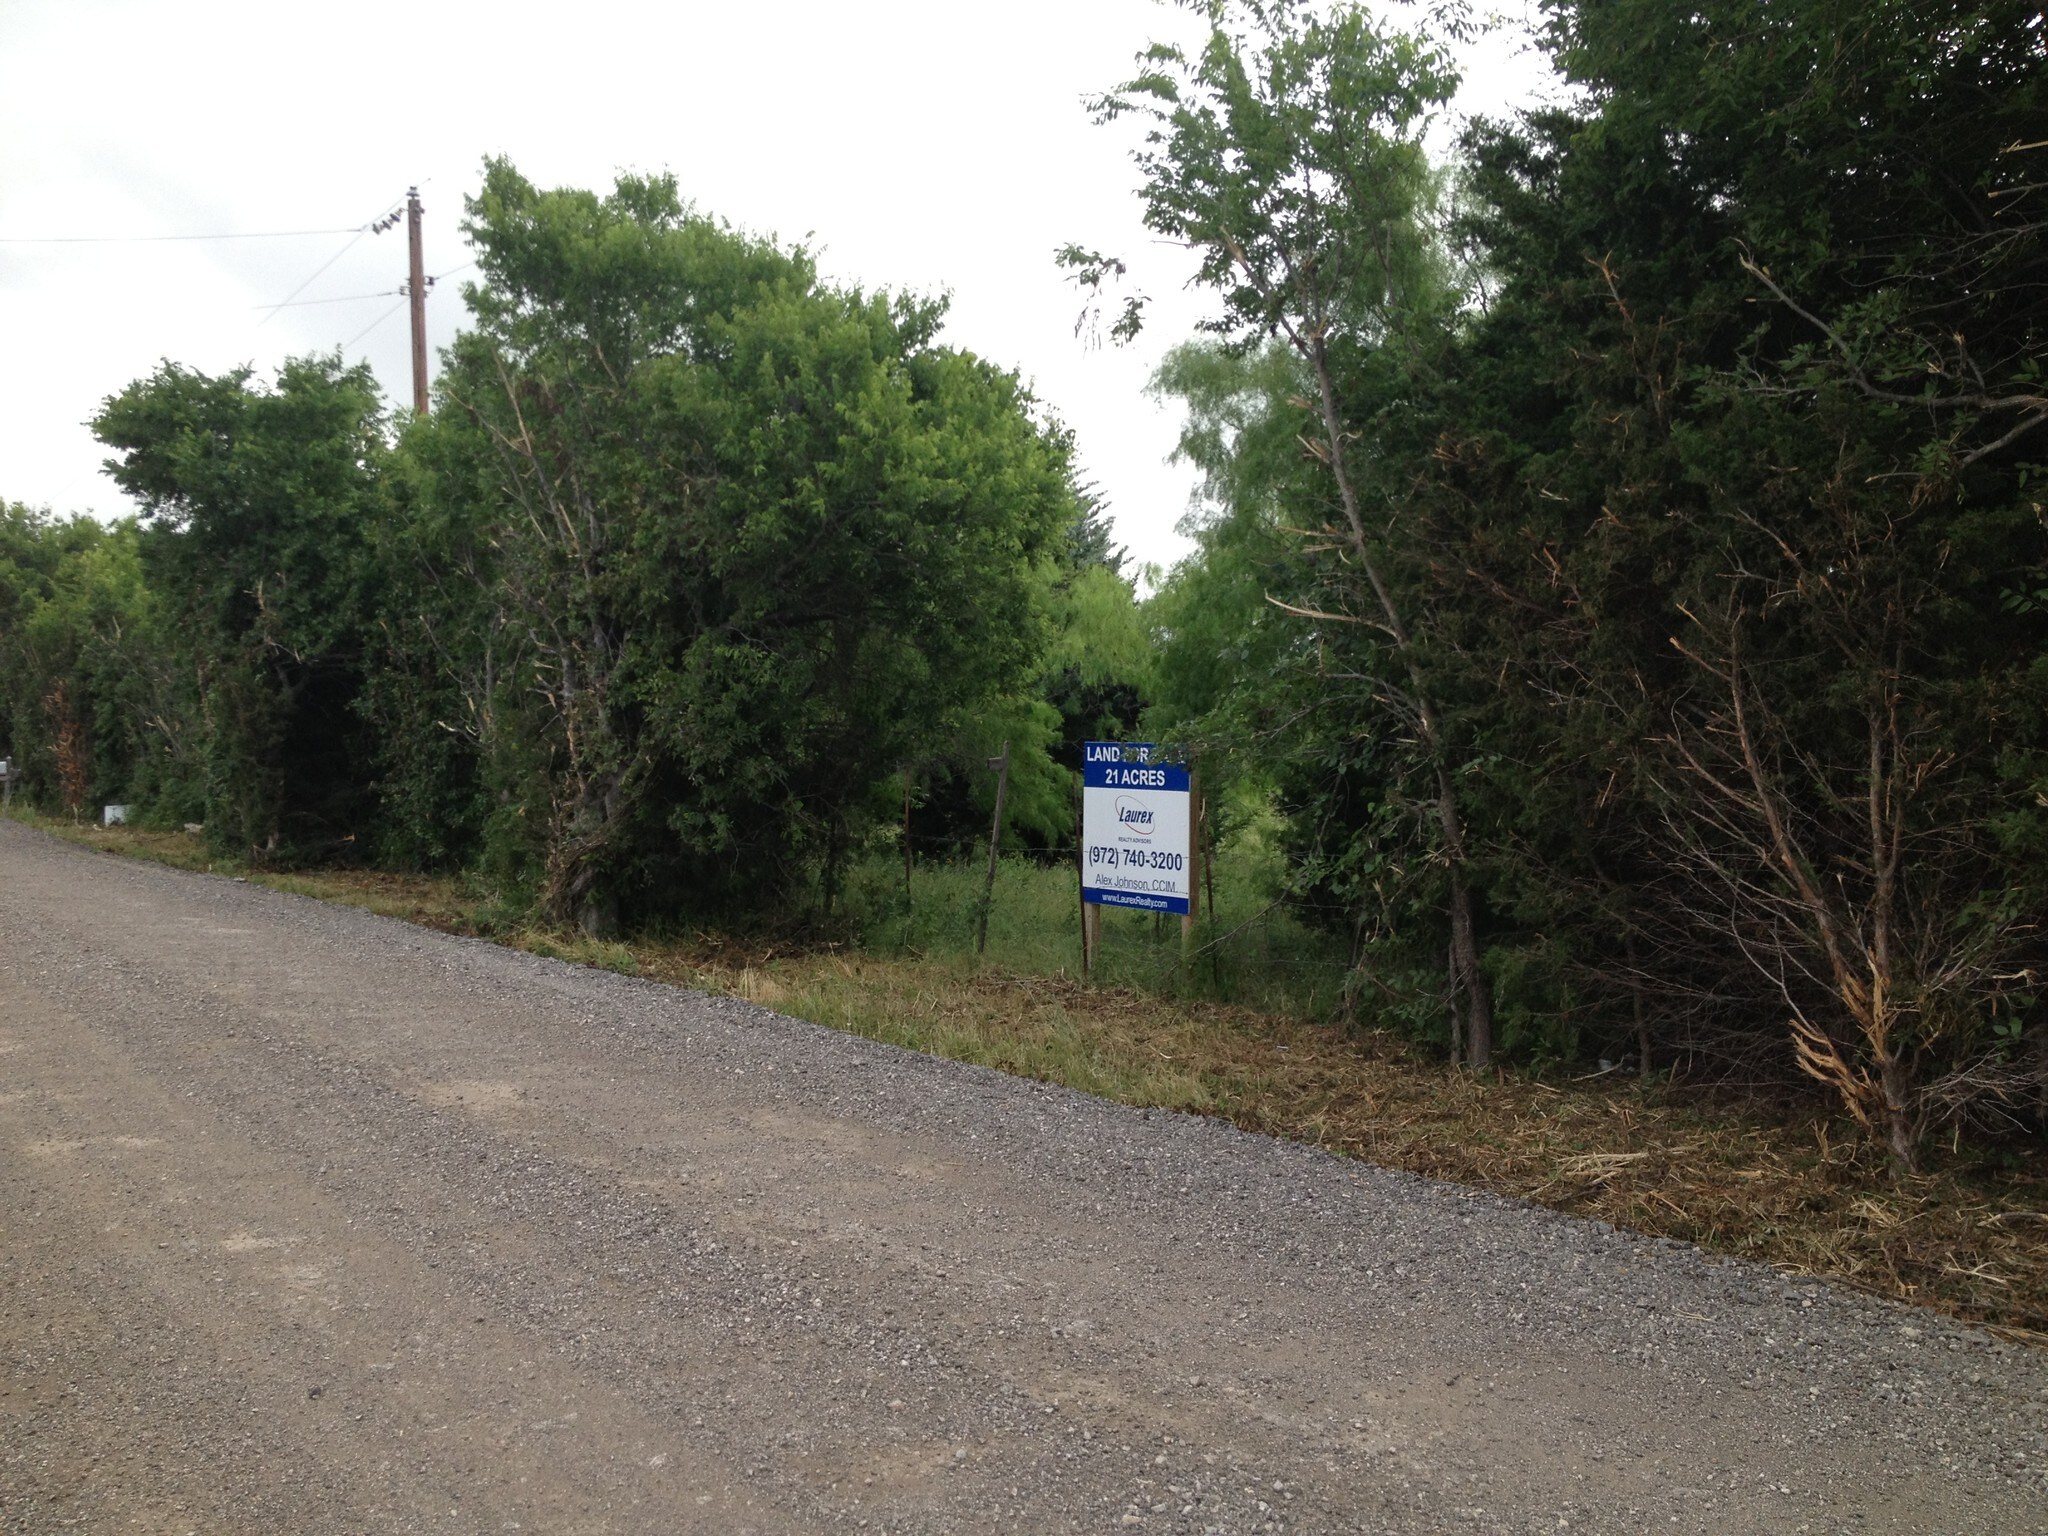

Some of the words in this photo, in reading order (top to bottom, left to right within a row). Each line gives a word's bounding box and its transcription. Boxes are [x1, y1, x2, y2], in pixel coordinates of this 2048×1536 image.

[1086, 746, 1120, 762] LAND
[1105, 768, 1119, 784] 21
[1121, 769, 1166, 786] ACRES
[1119, 806, 1154, 824] Laurex
[1089, 845, 1119, 869] (972)
[1123, 849, 1183, 871] 740-3200
[1095, 873, 1113, 886] Alex
